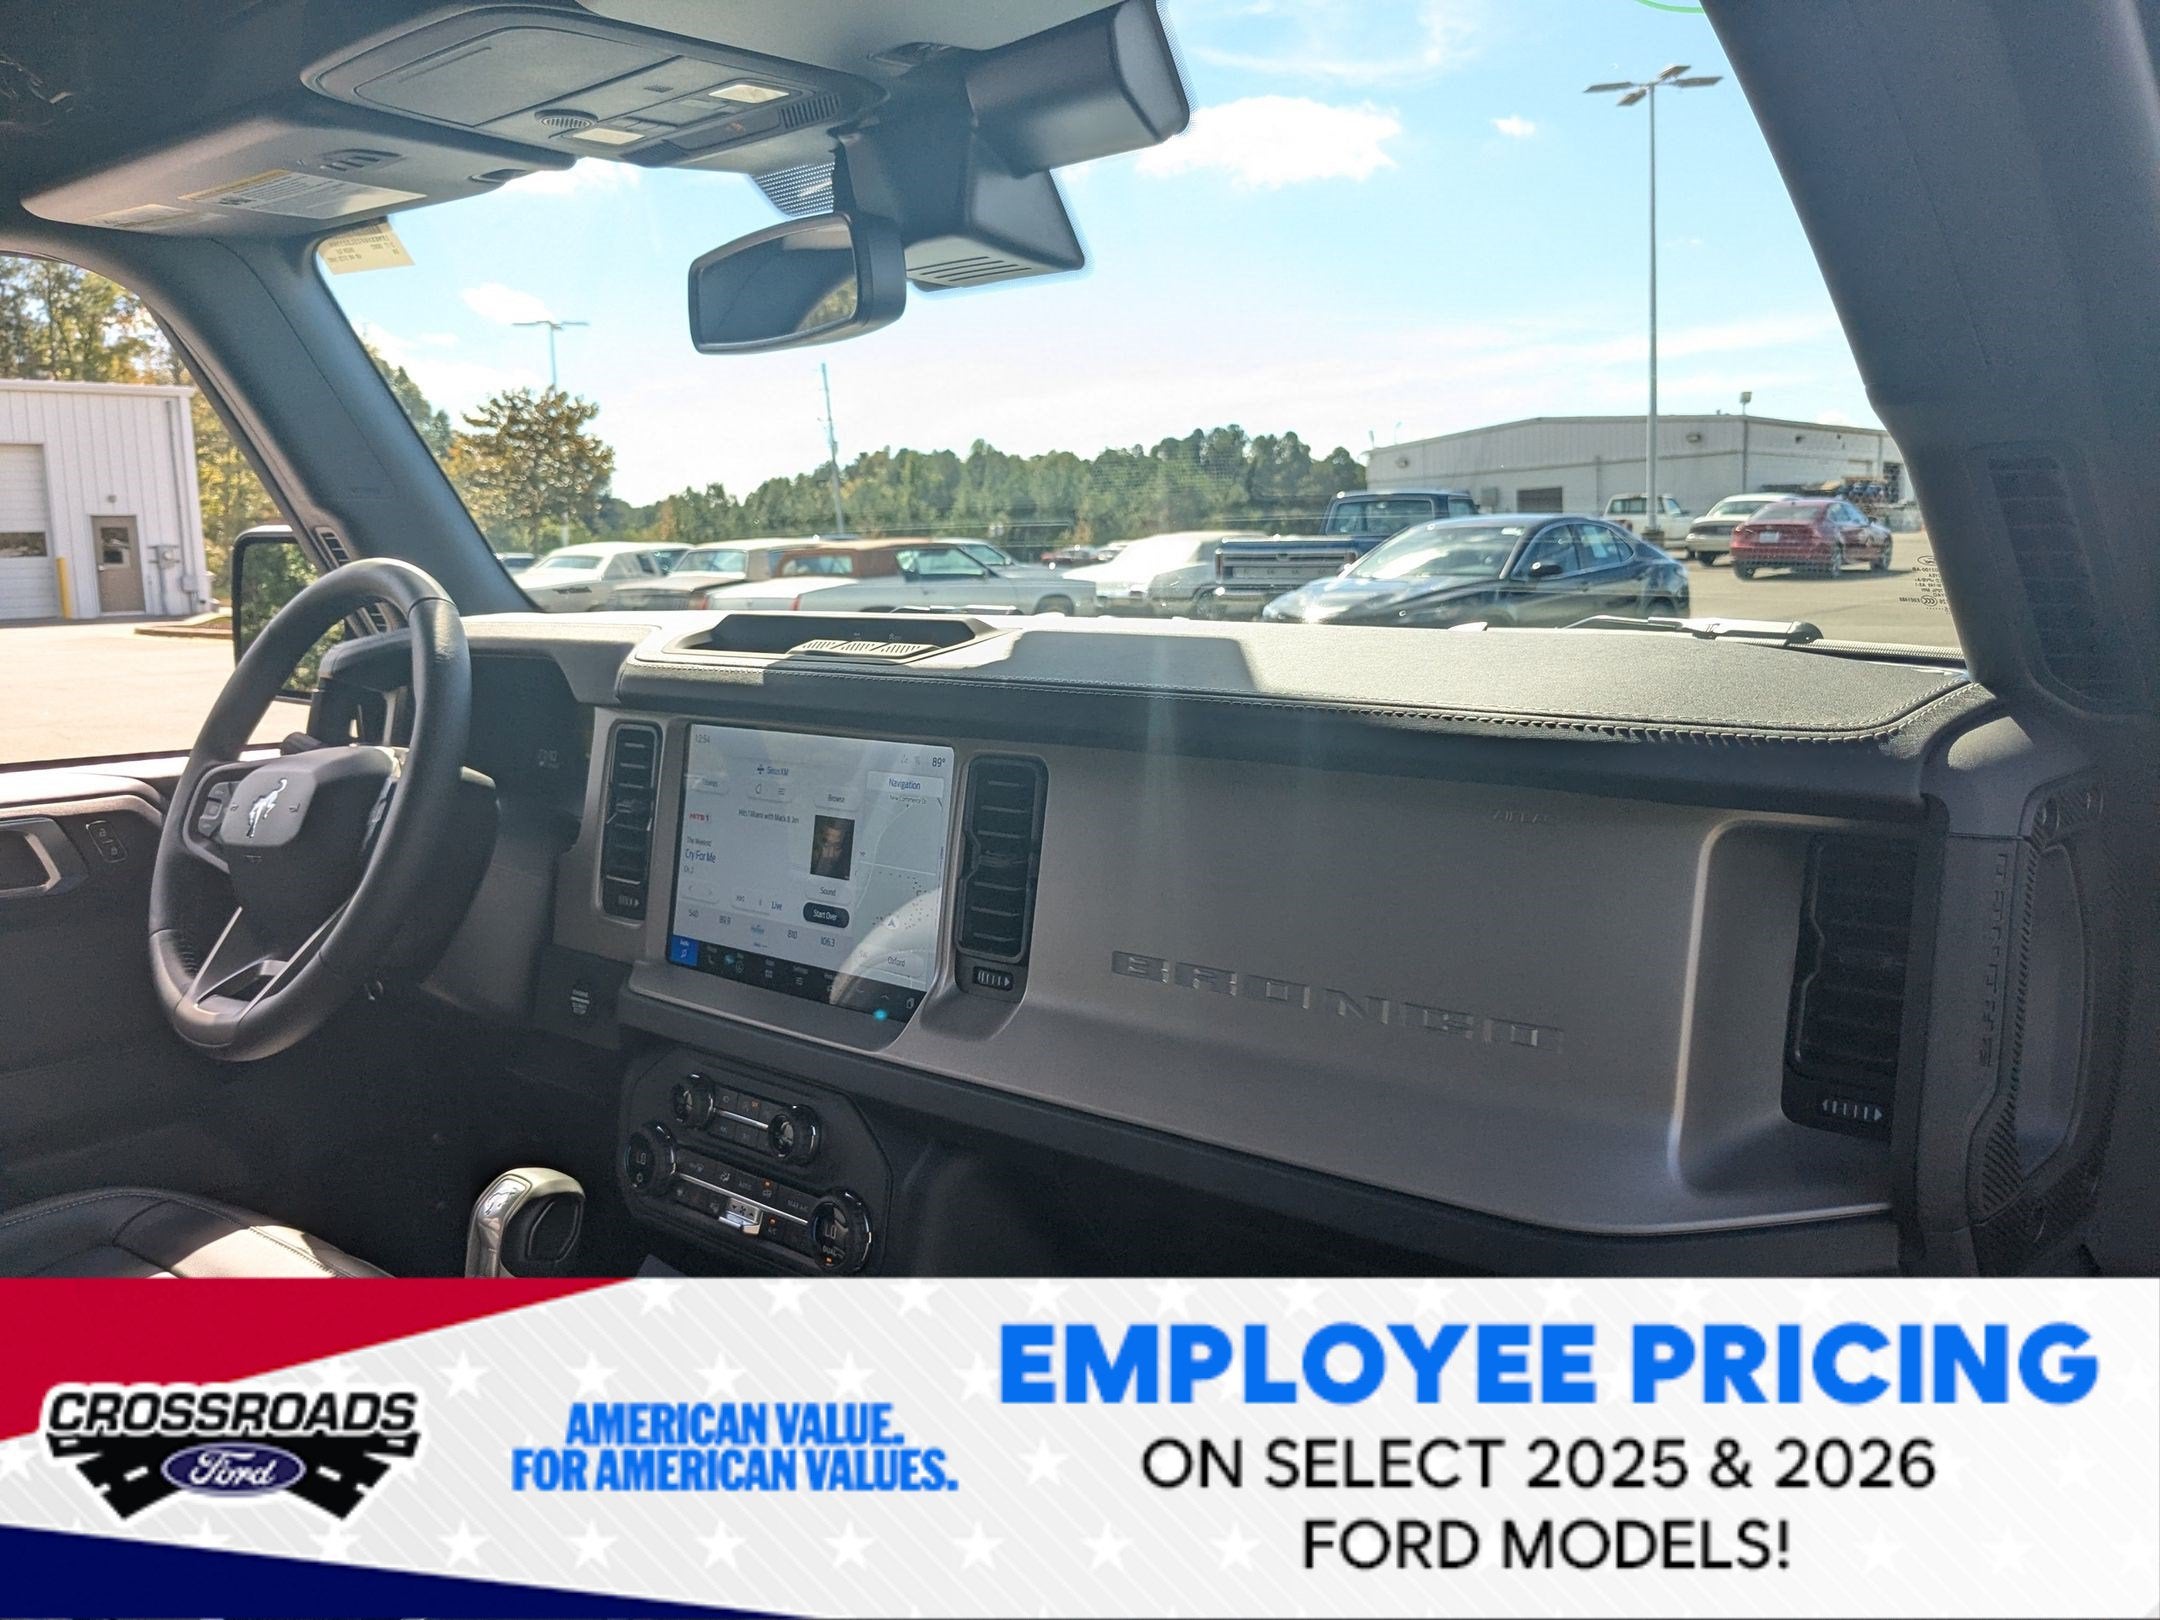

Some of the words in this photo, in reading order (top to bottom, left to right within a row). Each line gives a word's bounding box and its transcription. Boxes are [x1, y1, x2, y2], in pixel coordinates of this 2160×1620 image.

[889, 778, 920, 790] Navigation
[685, 849, 694, 861] Cry
[696, 850, 705, 861] For
[706, 852, 716, 863] Me
[771, 901, 782, 910] Live
[813, 908, 825, 919] Start
[826, 911, 837, 921] Over
[1112, 950, 1564, 1054] BRONCO
